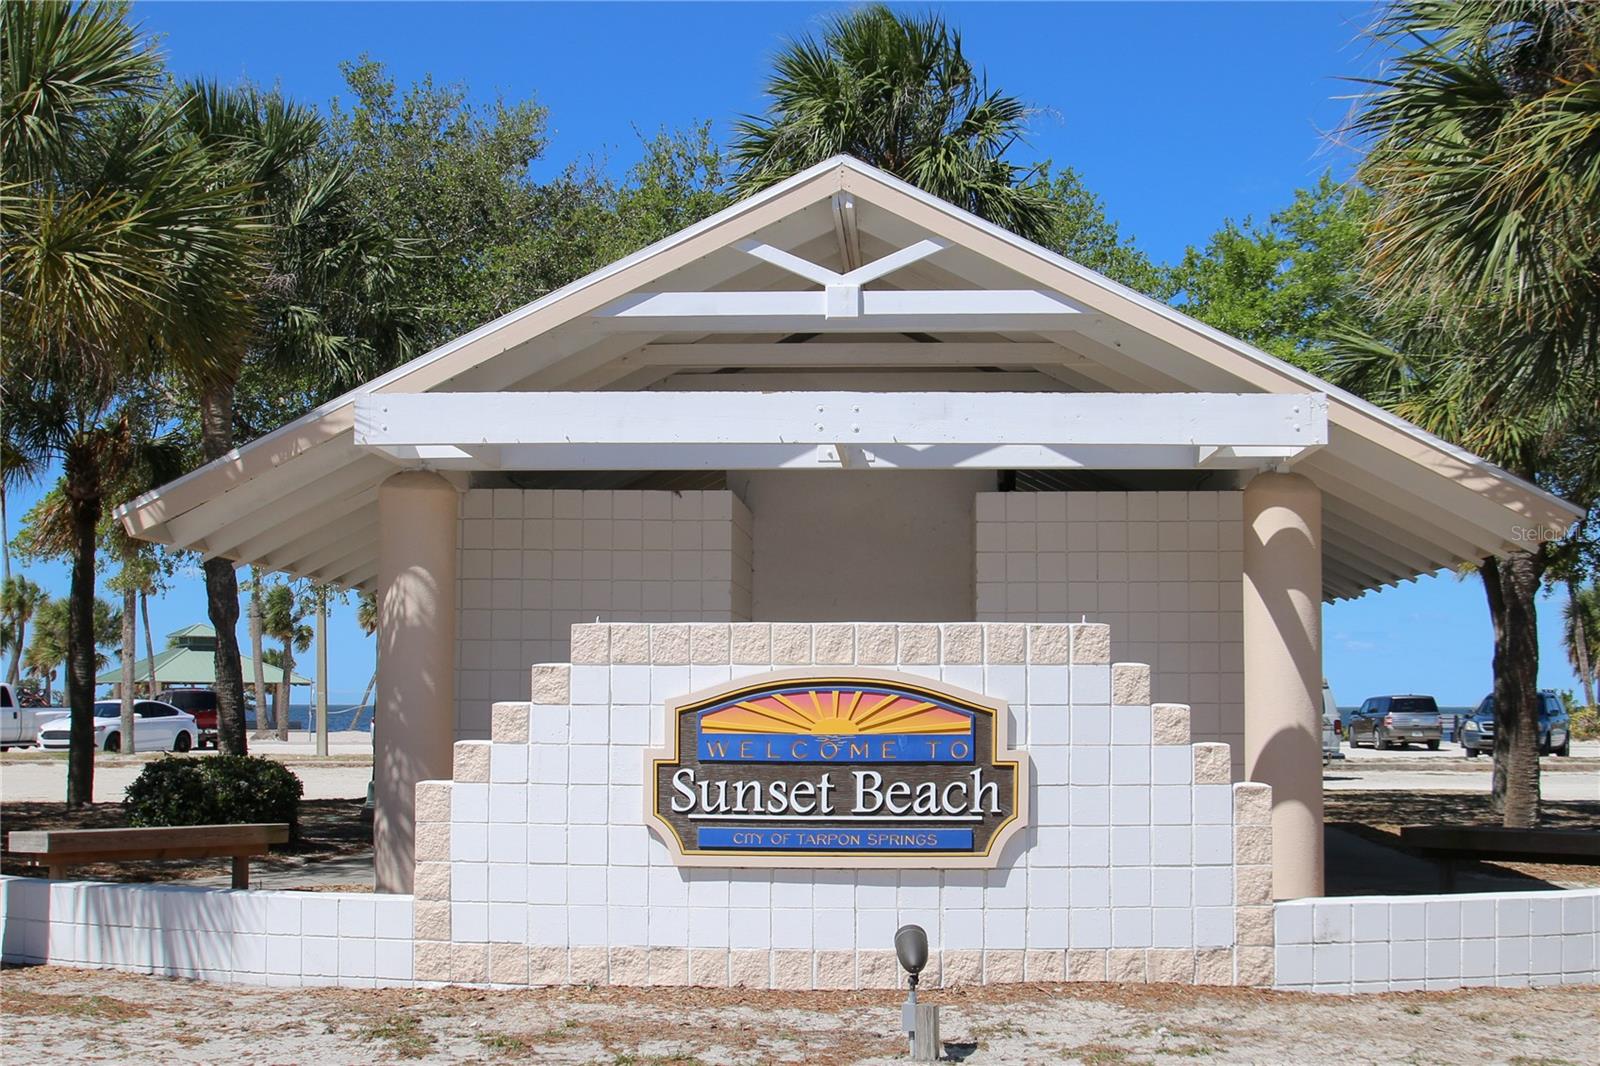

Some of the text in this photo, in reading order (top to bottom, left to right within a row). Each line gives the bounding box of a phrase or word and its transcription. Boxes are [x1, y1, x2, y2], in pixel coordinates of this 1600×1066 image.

[706, 740, 969, 760] WELCOME TO
[671, 768, 1002, 815] Sunset Beach
[732, 832, 938, 847] CITY OF TARPON SPRINGS
